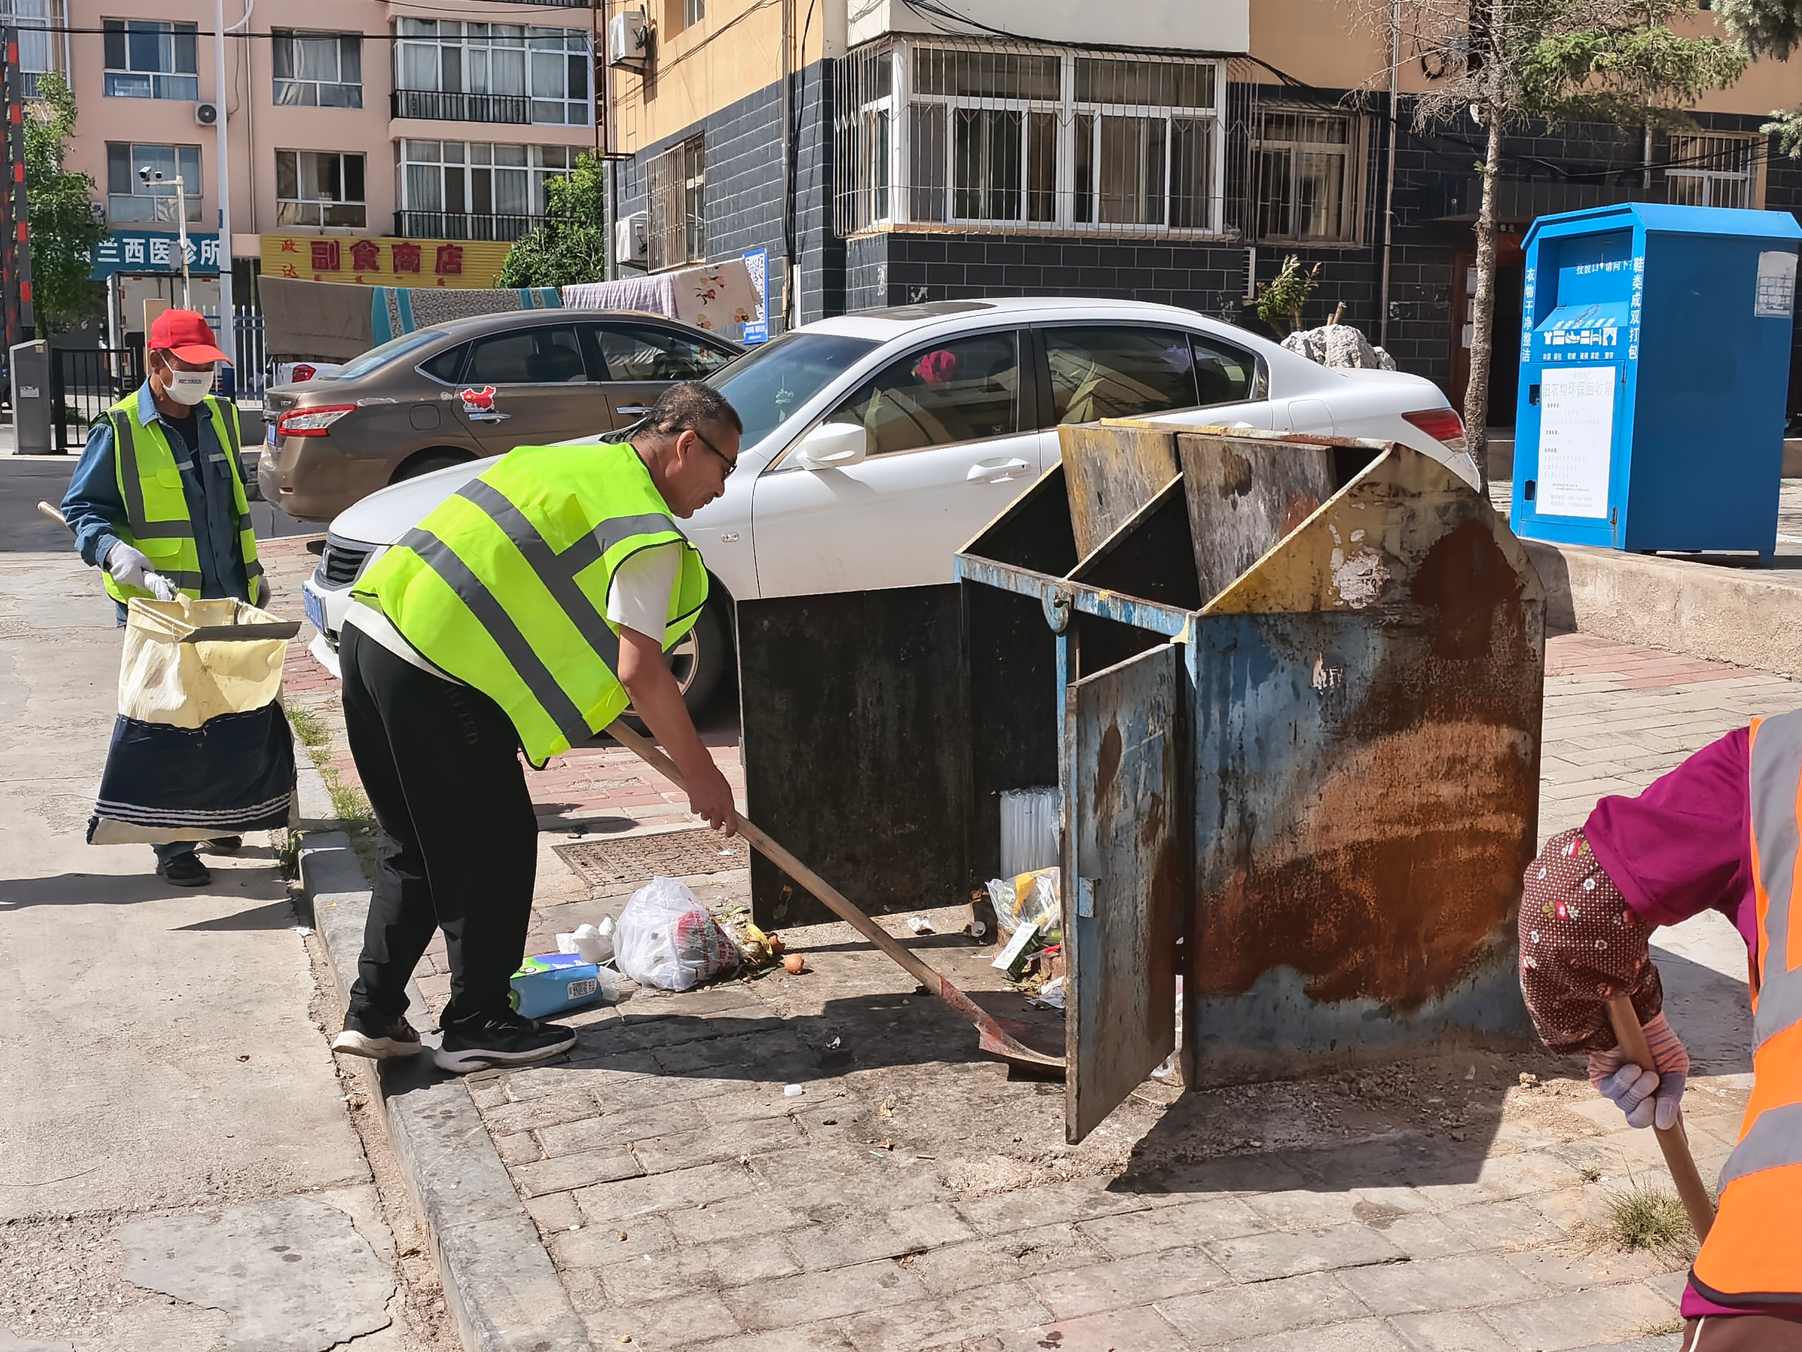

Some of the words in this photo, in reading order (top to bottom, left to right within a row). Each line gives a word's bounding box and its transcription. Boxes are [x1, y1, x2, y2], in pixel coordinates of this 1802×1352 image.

[72, 237, 220, 265] 兰西医诊所
[310, 239, 464, 275] 副食商店
[1628, 256, 1645, 360] 鞋类成双打包
